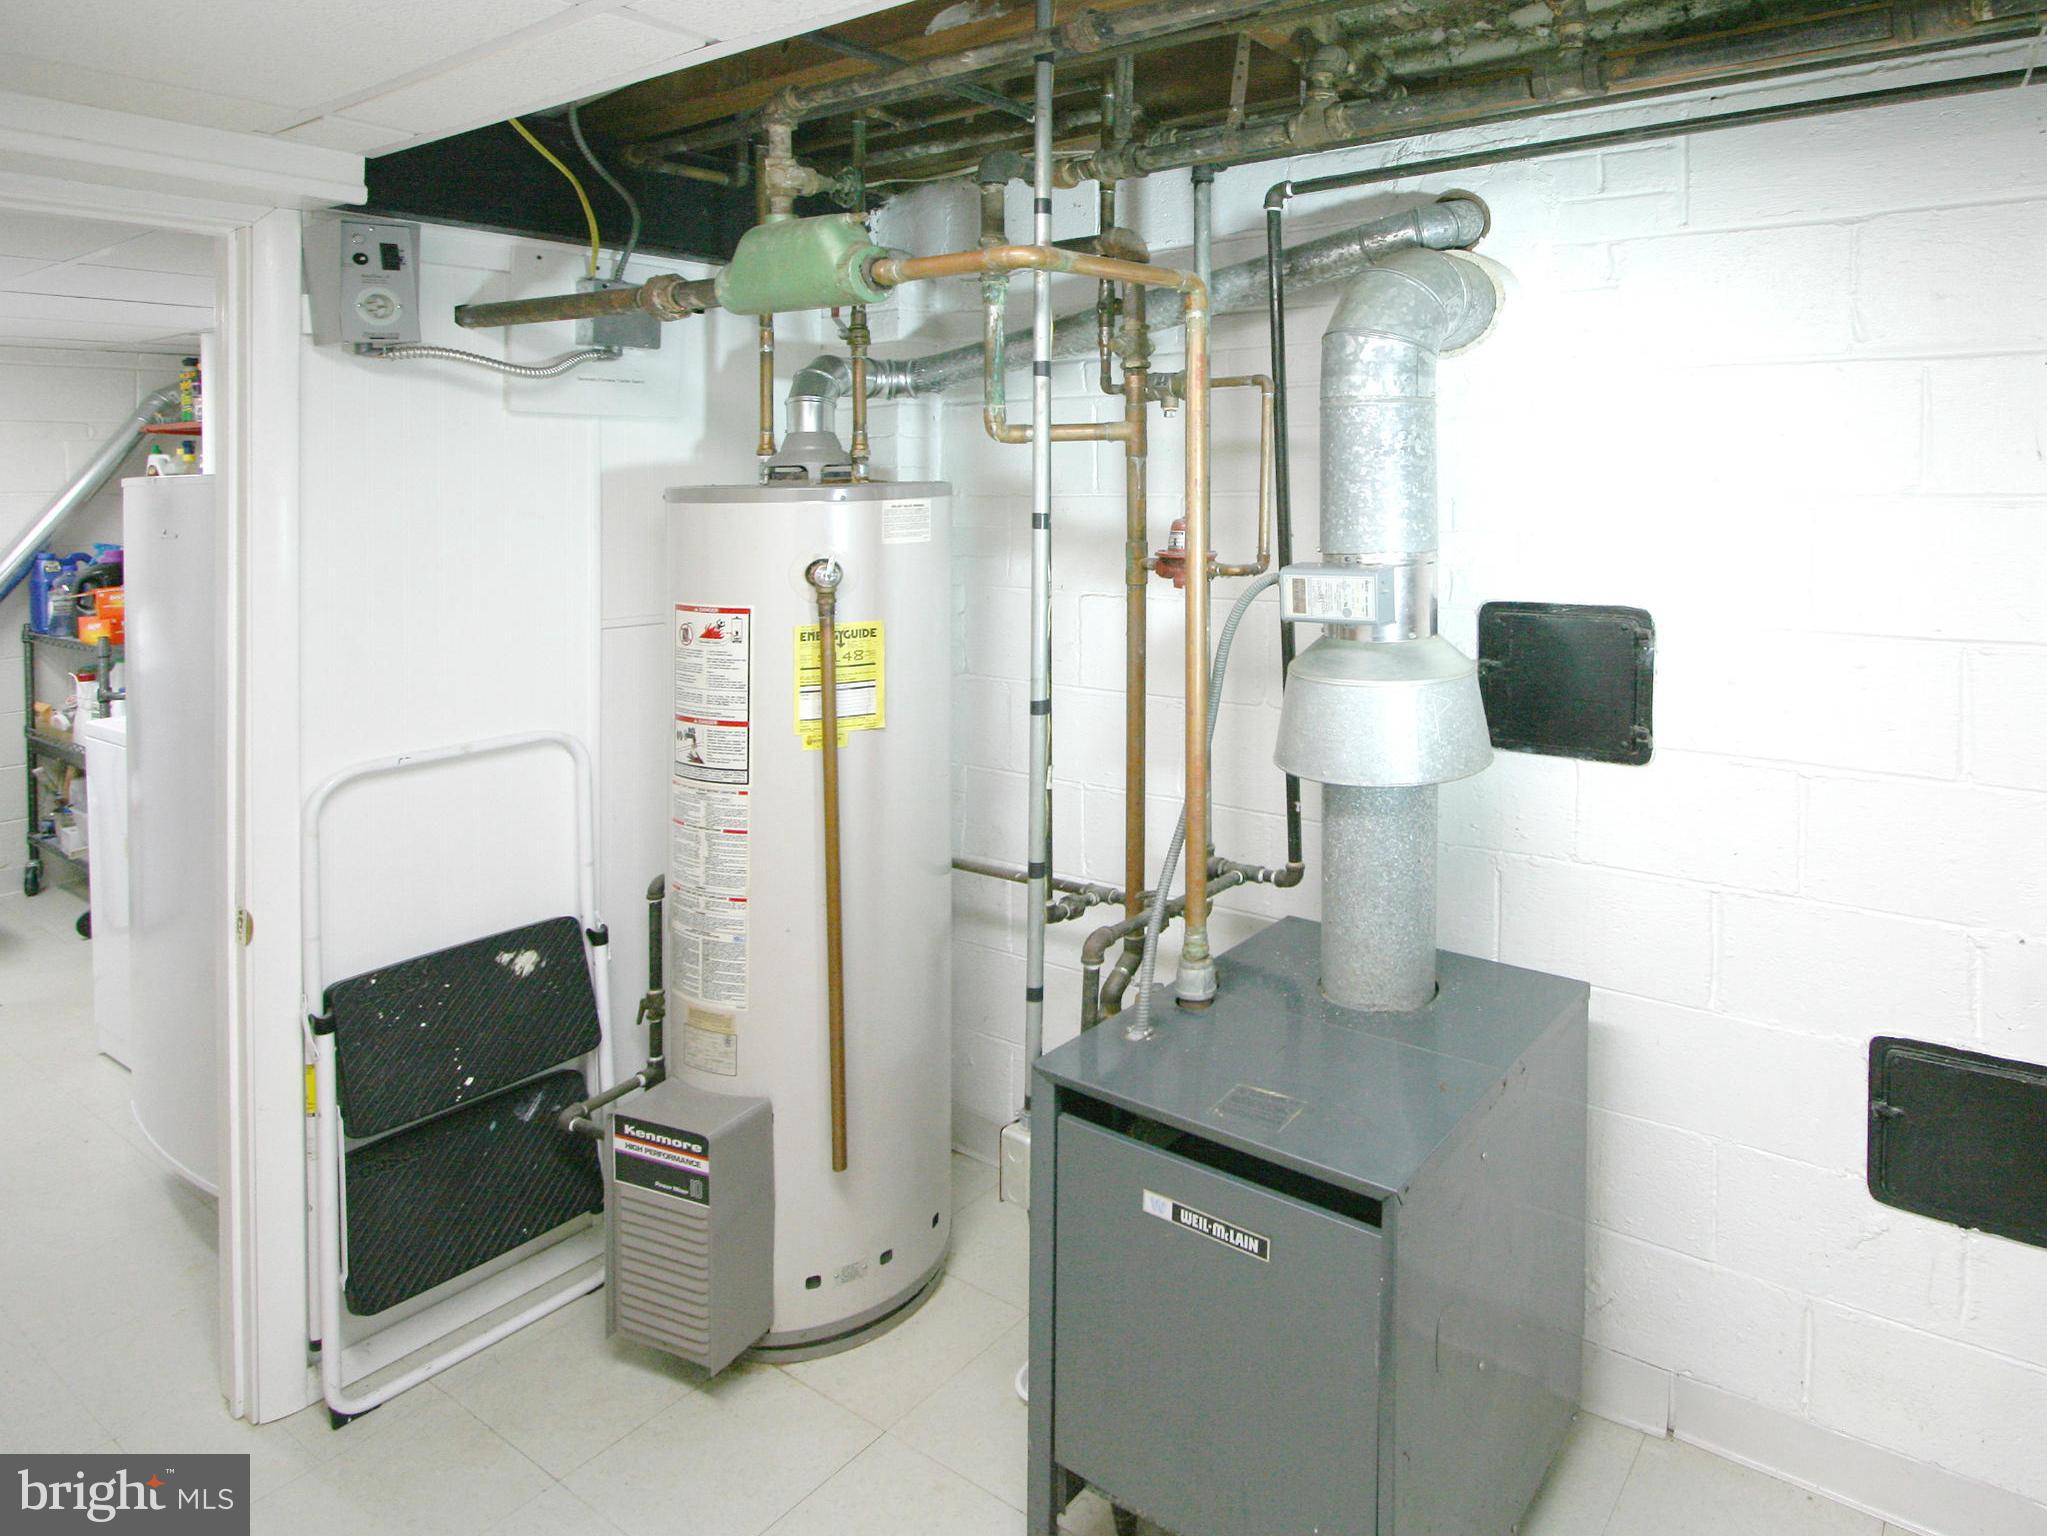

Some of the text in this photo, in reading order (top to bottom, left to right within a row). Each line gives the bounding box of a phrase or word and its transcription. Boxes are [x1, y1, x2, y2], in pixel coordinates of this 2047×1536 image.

[624, 1124, 702, 1153] Kenmore
[625, 1142, 701, 1169] HIGH PERFORMANCE
